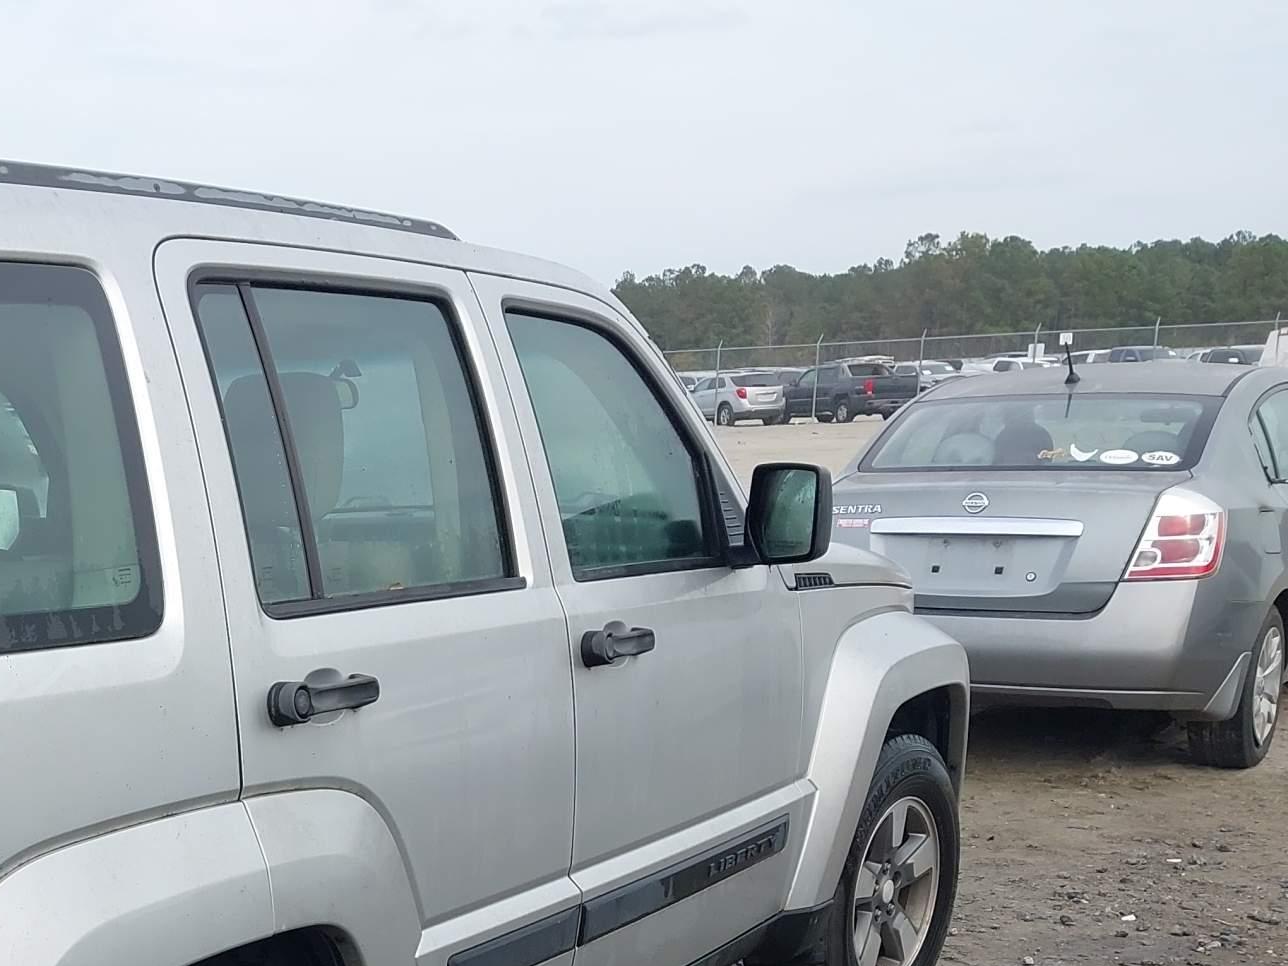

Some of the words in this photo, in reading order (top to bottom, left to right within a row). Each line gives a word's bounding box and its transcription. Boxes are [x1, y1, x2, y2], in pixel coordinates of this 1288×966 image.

[1148, 454, 1174, 462] SAV
[832, 504, 882, 515] SENTRA
[708, 834, 777, 878] LIBERTY
